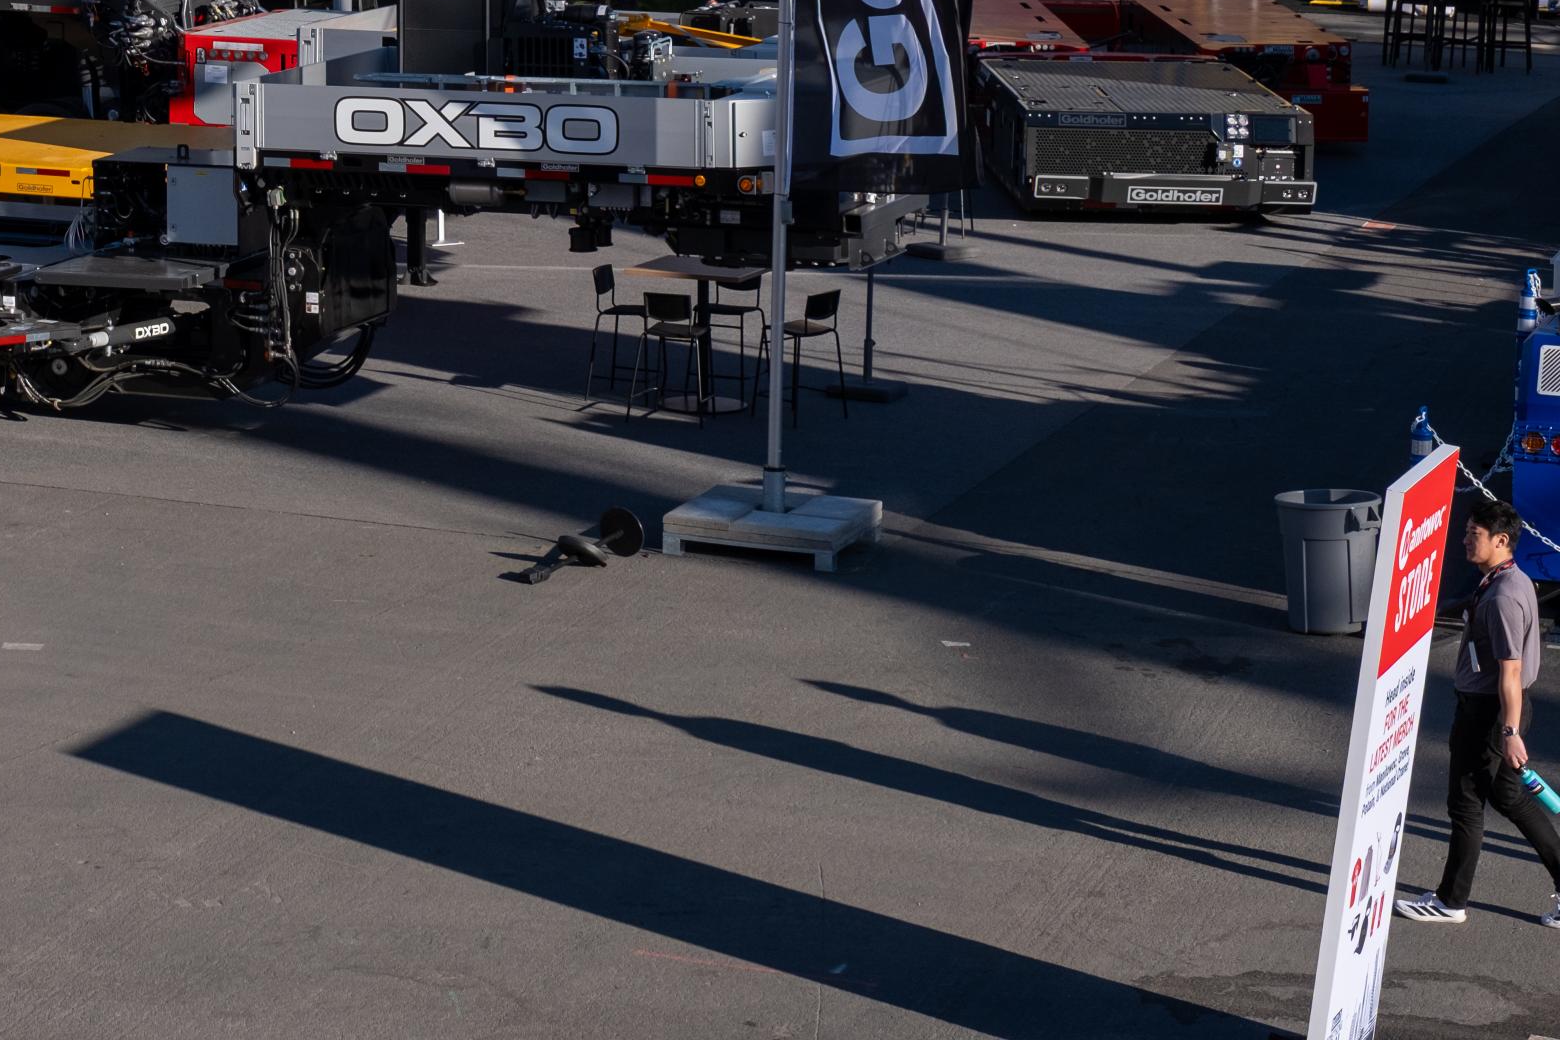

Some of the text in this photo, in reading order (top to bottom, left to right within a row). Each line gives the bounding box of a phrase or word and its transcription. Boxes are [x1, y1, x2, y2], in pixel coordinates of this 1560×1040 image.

[333, 96, 621, 156] OXBO
[1060, 113, 1125, 126] Goldhofer
[1131, 189, 1220, 203] Goldhofer
[1394, 549, 1438, 633] STORE
[1384, 666, 1416, 710] Head inside
[1382, 693, 1410, 736] FOR THE
[1369, 711, 1416, 774] LATEST MERCH
